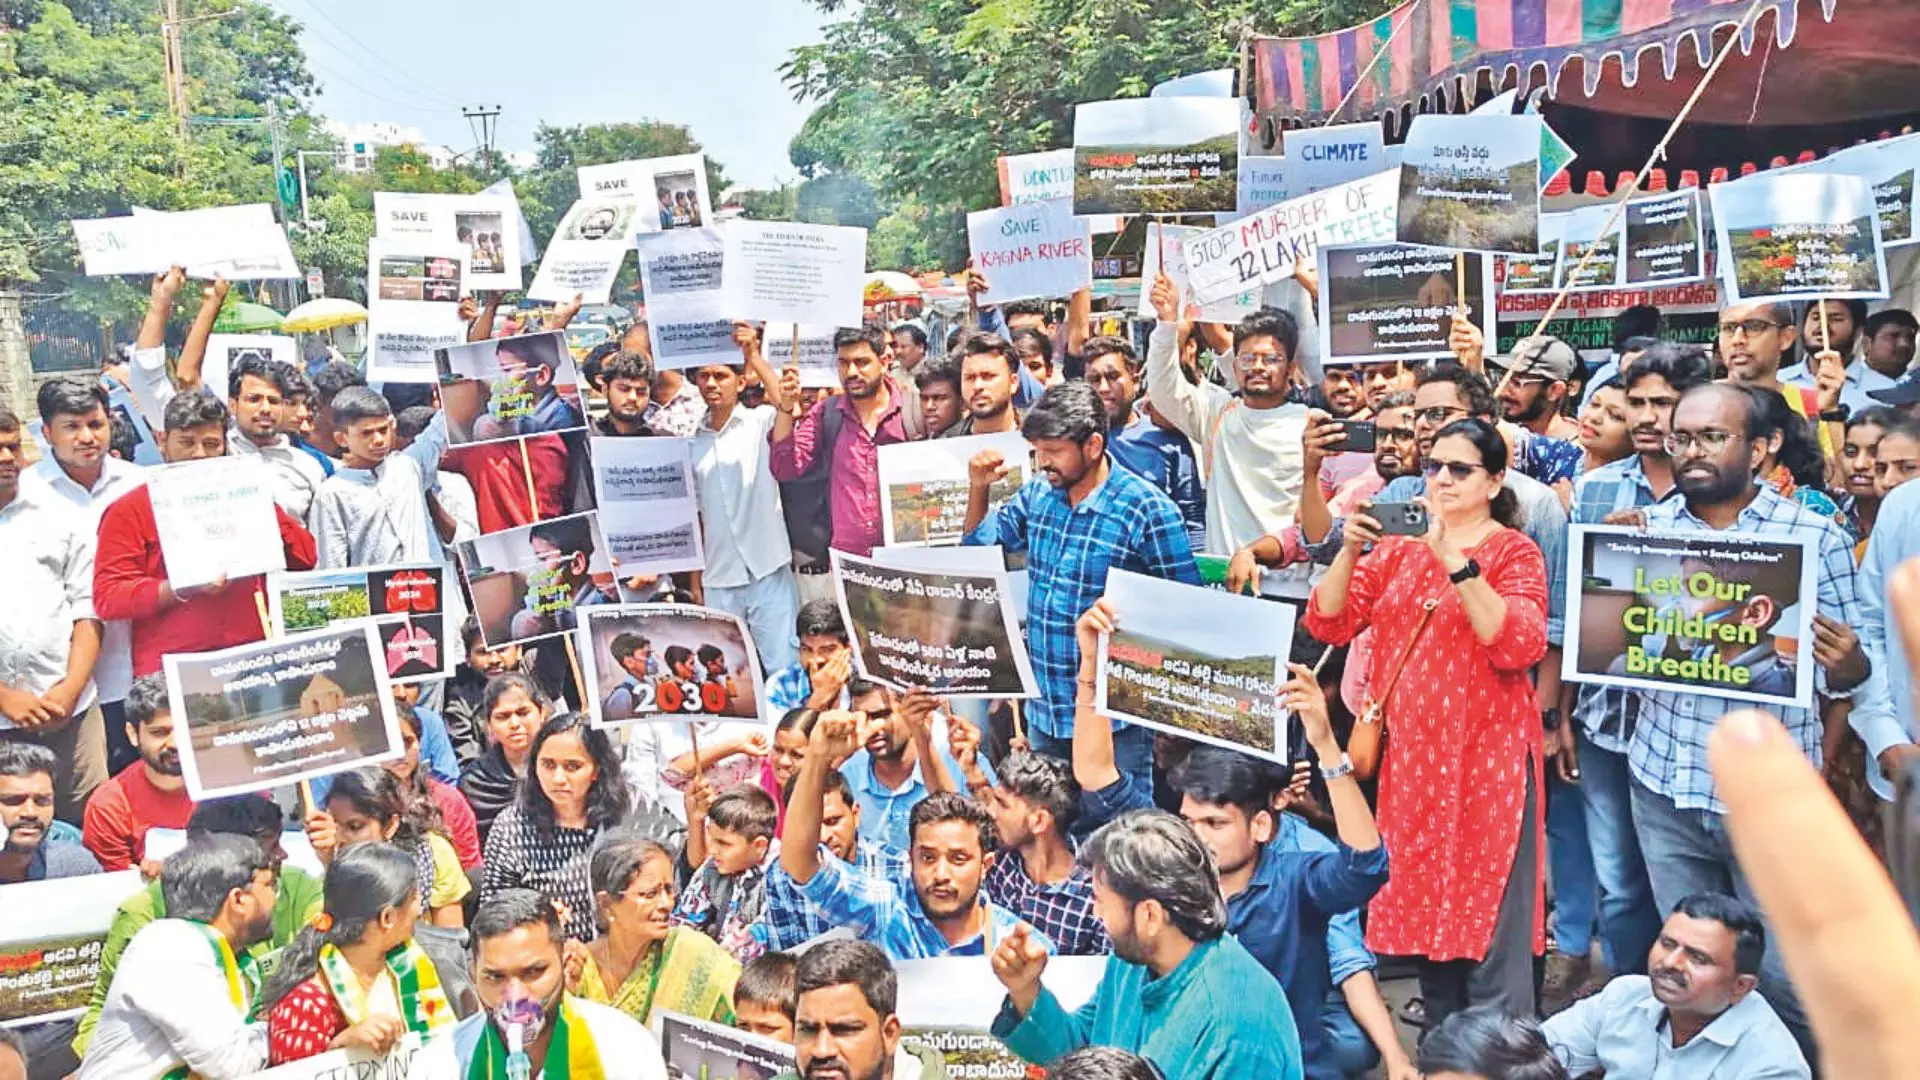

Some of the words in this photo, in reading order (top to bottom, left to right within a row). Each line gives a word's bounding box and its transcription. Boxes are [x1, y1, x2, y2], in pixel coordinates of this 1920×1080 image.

[1302, 143, 1367, 161] CLIMATE
[595, 178, 628, 191] SAVE
[391, 210, 429, 222] SAVE
[1002, 219, 1040, 236] SAVE
[1191, 230, 1237, 268] STOP
[1240, 197, 1329, 248] MURDER
[1346, 183, 1374, 212] OF
[981, 246, 1033, 268] KAGNA
[1038, 238, 1085, 260] RIVER
[1260, 229, 1319, 272] LAKH
[1325, 205, 1397, 242] TREES
[1516, 320, 1569, 335] PROEST
[1572, 318, 1613, 334] AGAIN
[1635, 568, 1681, 595] Let
[1688, 571, 1752, 602] Our
[1623, 606, 1758, 645] Children
[1626, 646, 1752, 685] Breathe
[632, 682, 727, 714] 2030
[945, 1060, 1026, 1079] రాబాదును
